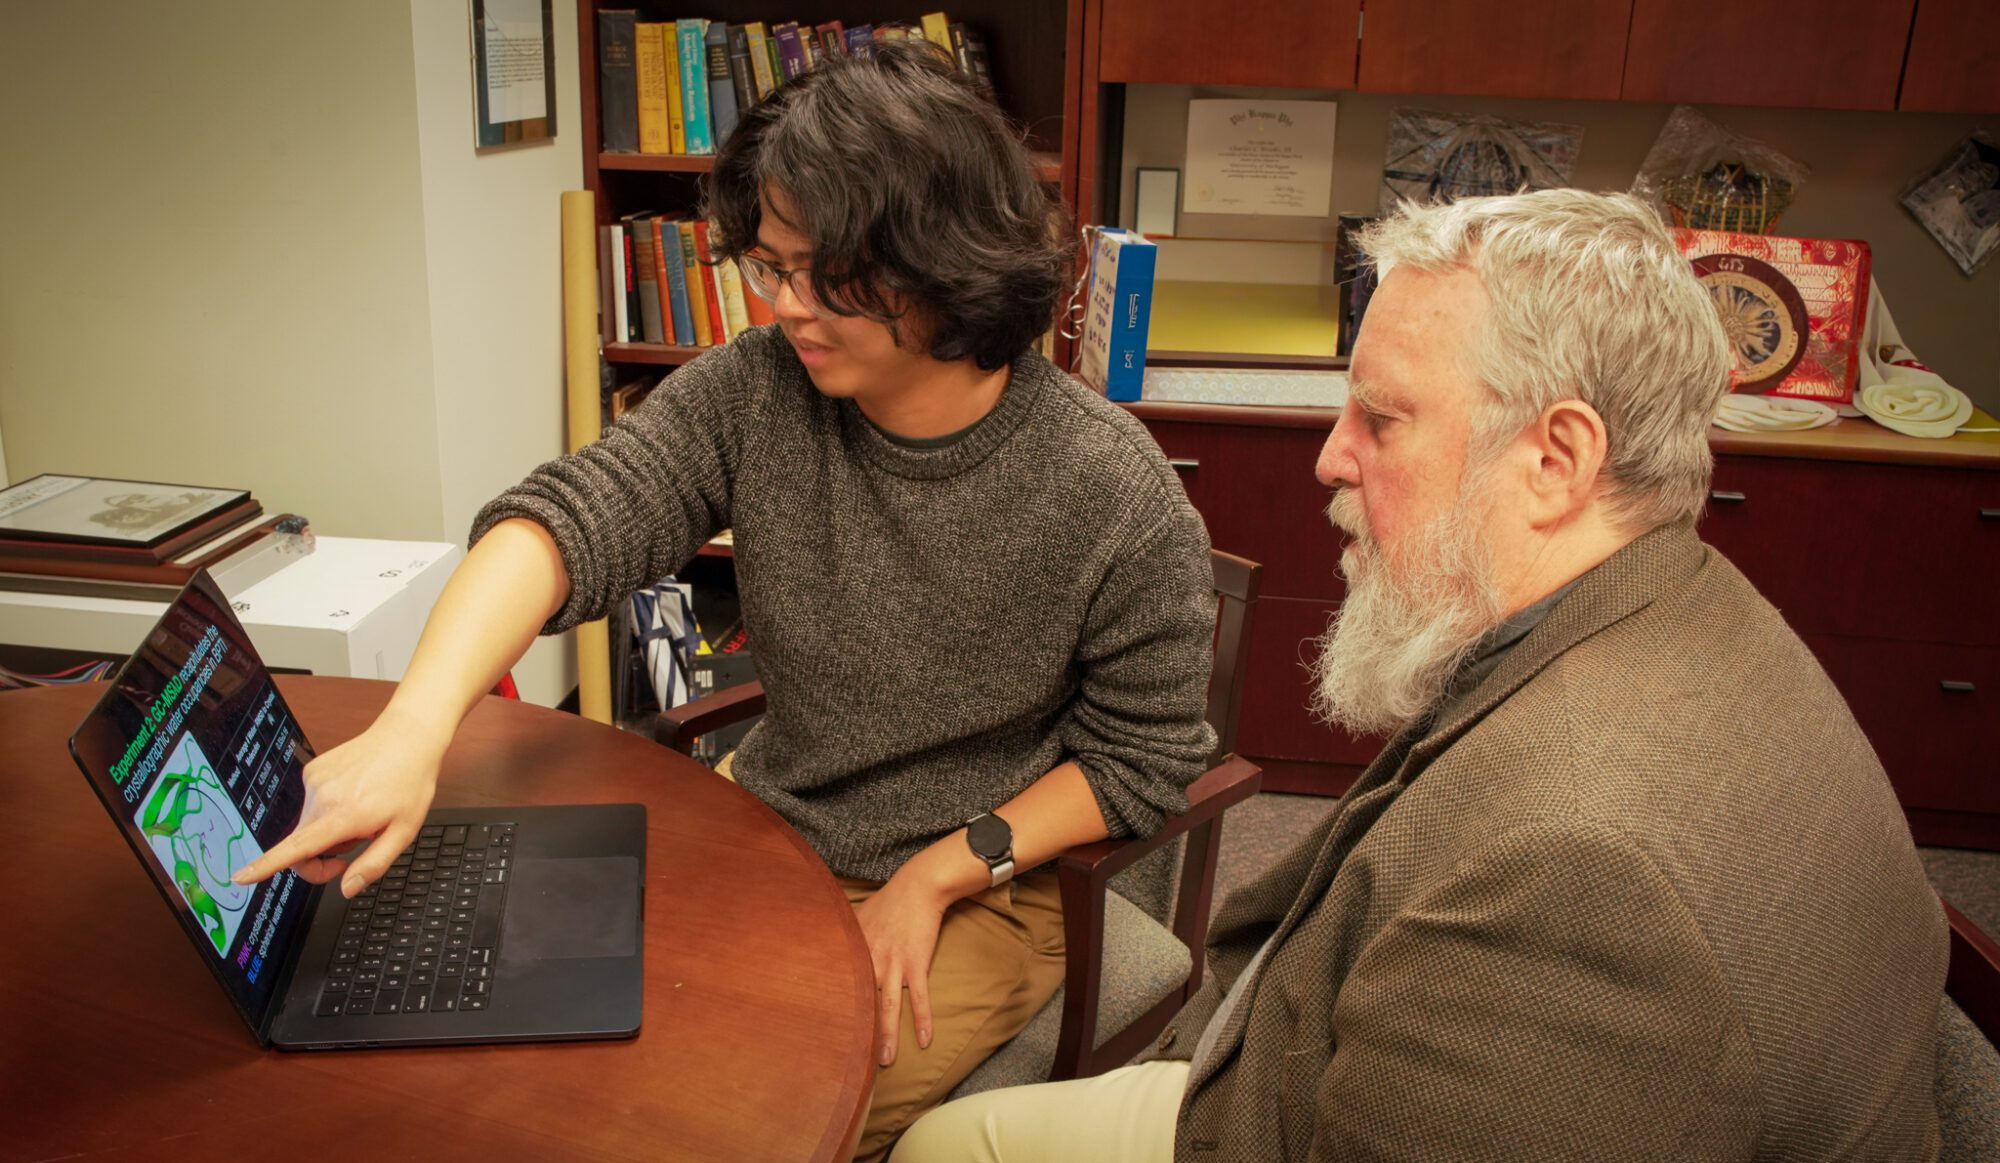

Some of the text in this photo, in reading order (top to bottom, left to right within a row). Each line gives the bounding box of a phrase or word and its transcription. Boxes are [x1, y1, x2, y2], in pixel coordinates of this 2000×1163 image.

[109, 724, 151, 784] Experiment
[179, 635, 211, 683] recapitulates
[205, 624, 218, 642] the
[123, 731, 170, 803] crystallographic
[165, 707, 183, 736] water
[180, 664, 213, 714] occupancies
[206, 656, 218, 671] in
[237, 942, 252, 970] PINK:
[248, 887, 274, 945] crystallographic
[246, 873, 294, 984] BLUE: spherical water reservoir
